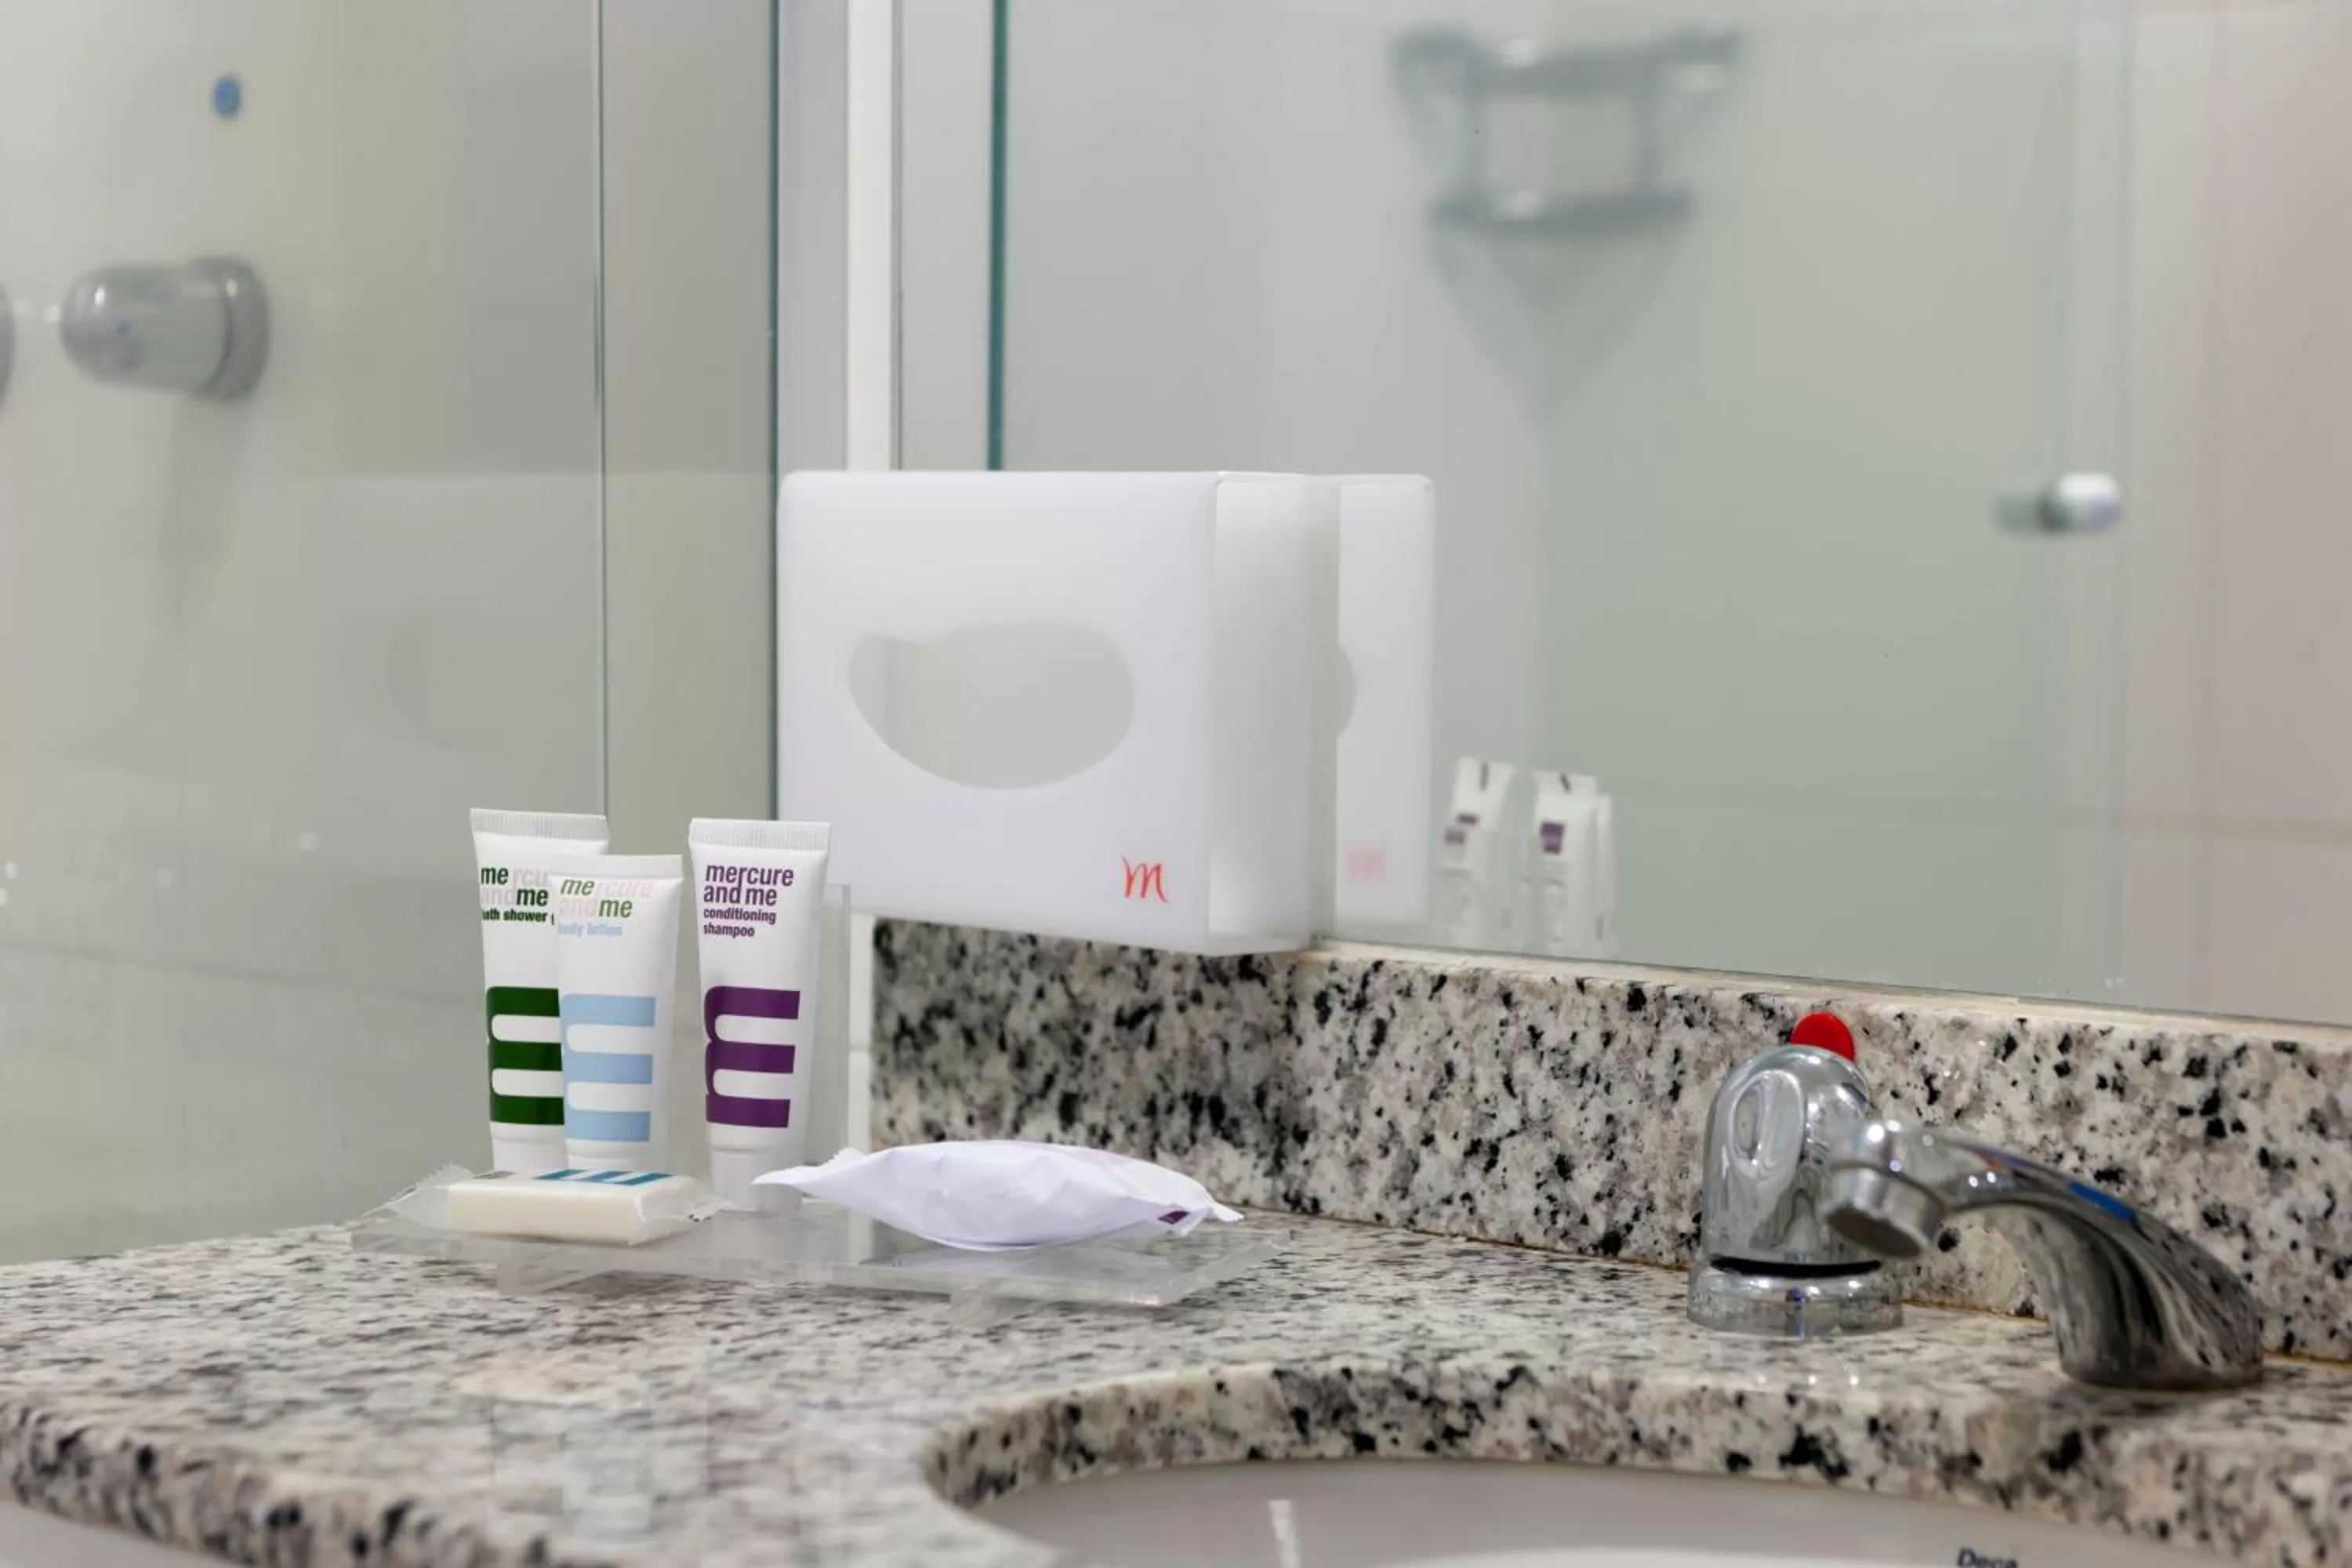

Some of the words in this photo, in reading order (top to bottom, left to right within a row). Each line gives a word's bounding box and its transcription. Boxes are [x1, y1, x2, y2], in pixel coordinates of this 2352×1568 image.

[705, 865, 794, 887] mercure
[516, 887, 549, 907] me
[703, 884, 742, 904] and
[745, 887, 778, 906] me
[481, 908, 500, 920] ath
[503, 909, 548, 922] shower
[598, 899, 633, 918] me
[703, 907, 777, 926] conditioning
[703, 922, 755, 939] shampoo
